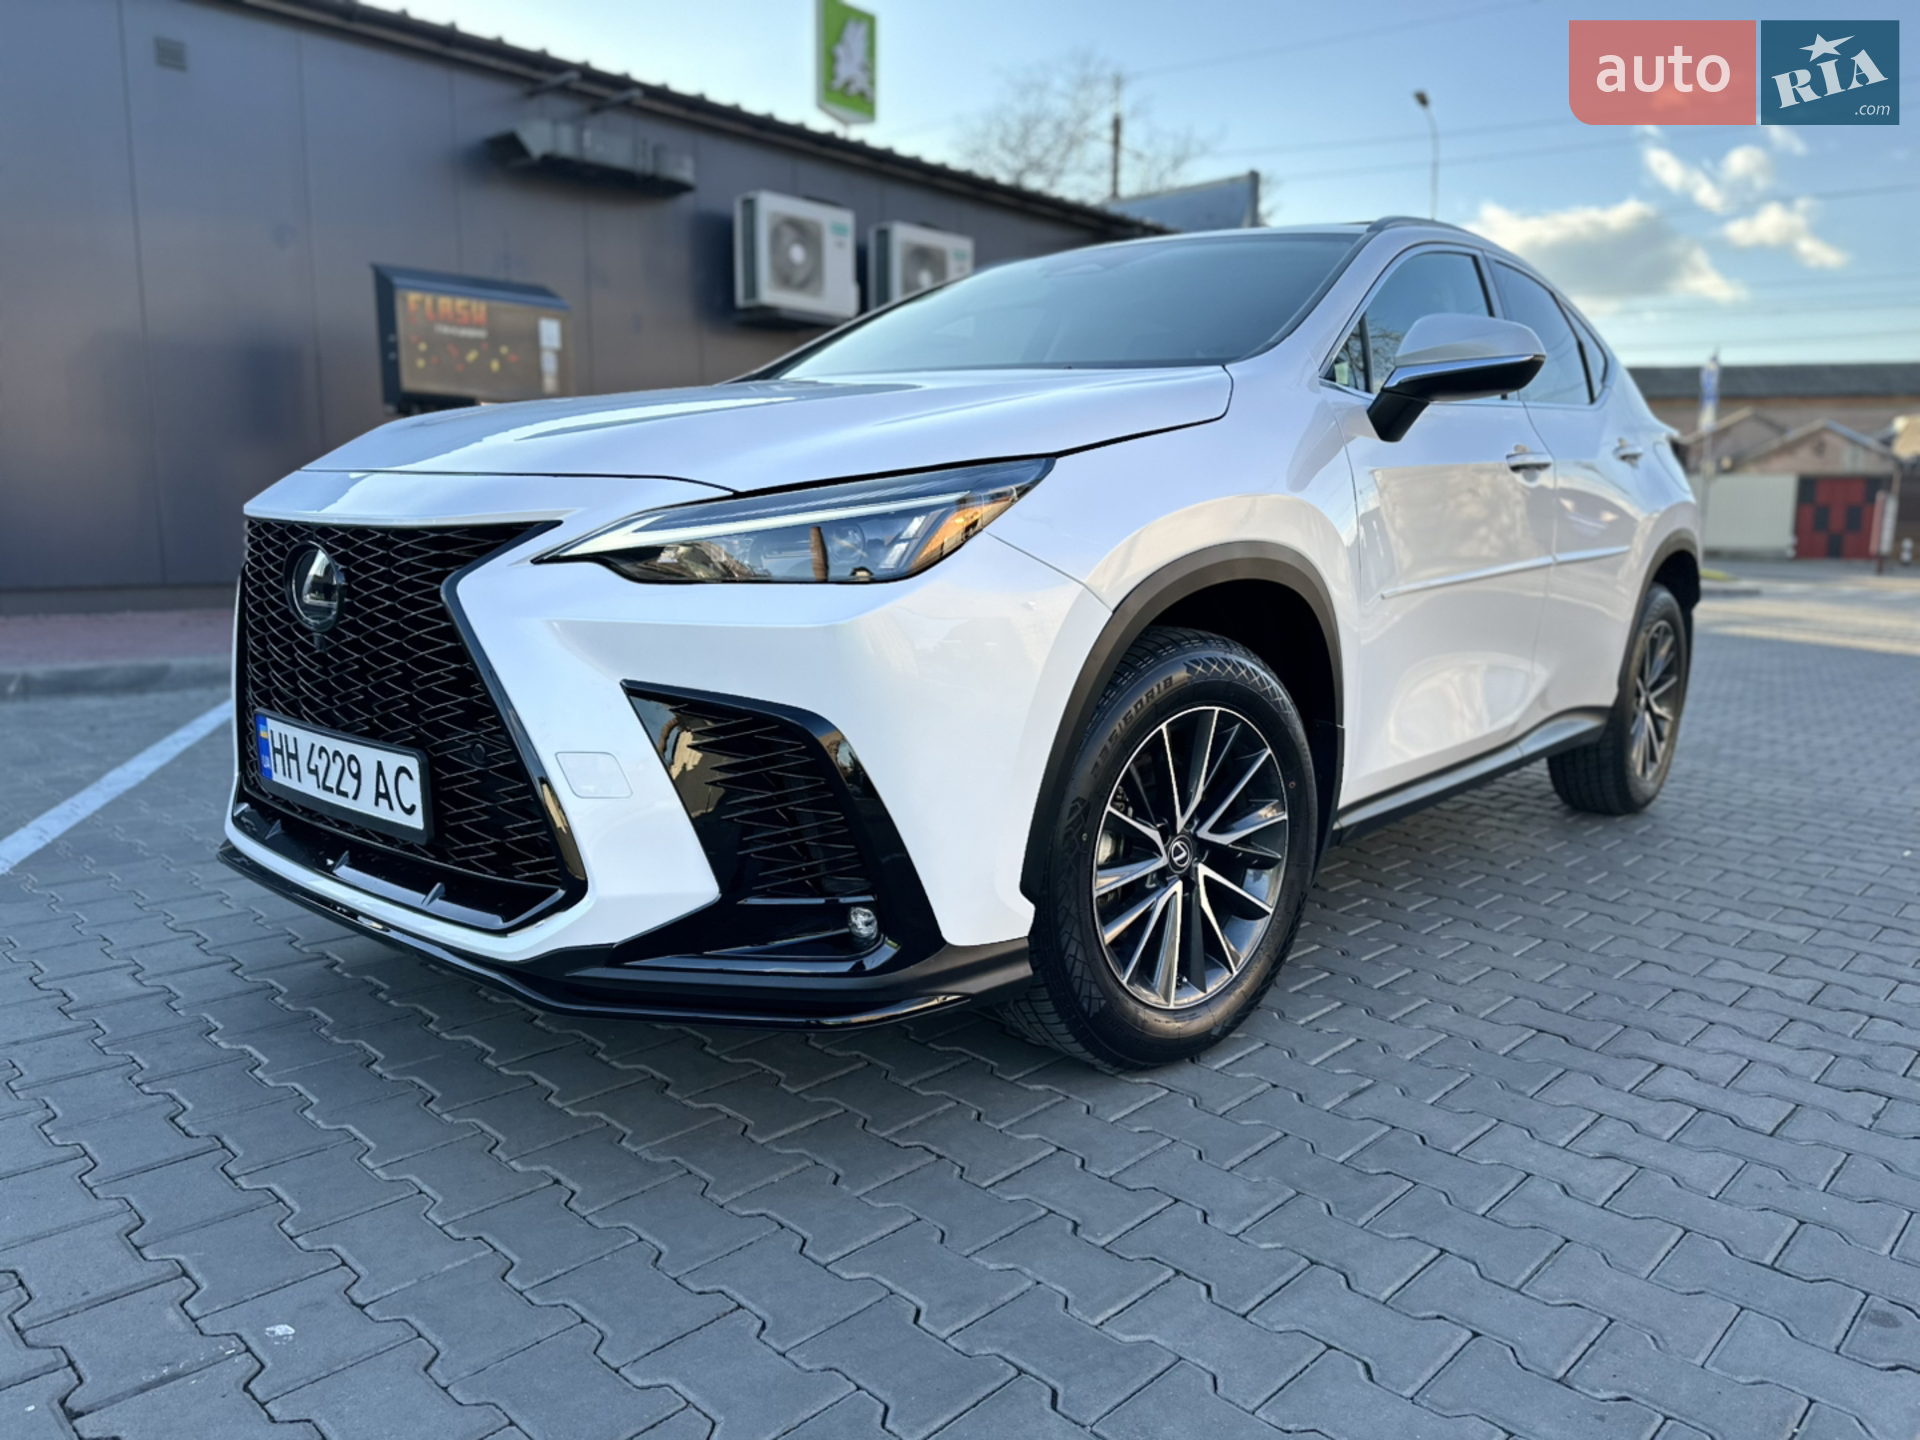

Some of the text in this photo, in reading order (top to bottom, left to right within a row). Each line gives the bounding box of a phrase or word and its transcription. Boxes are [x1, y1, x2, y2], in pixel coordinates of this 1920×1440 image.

[270, 729, 417, 816] HH 4229 AC
